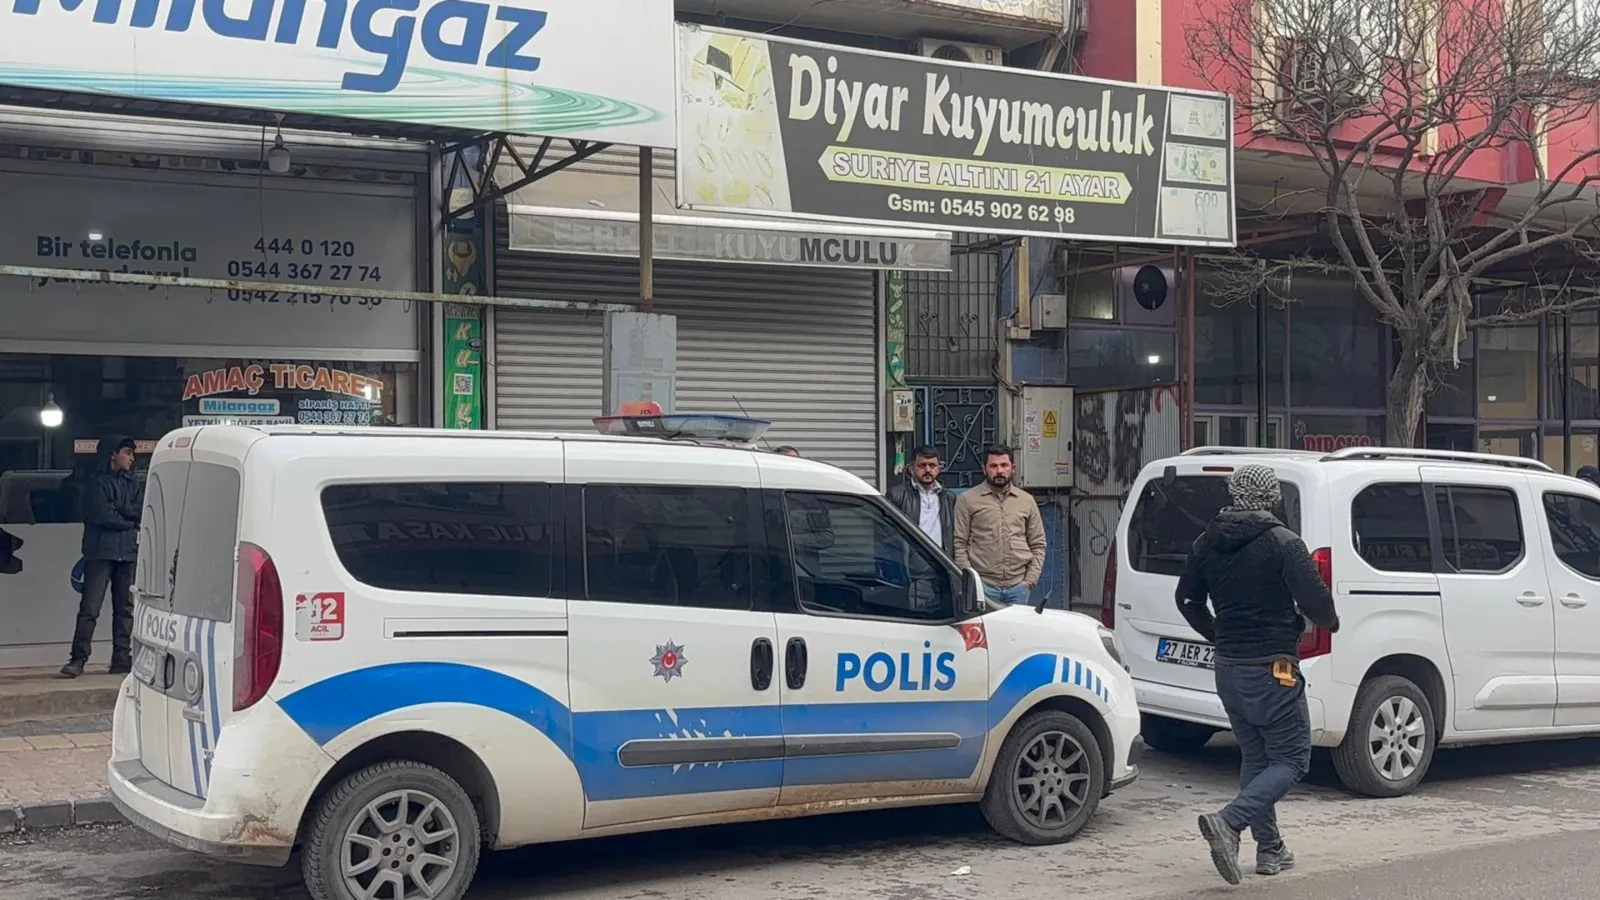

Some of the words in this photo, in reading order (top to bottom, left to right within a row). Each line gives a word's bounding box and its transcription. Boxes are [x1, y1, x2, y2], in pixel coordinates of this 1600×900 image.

[12, 0, 548, 92] angaz
[788, 53, 909, 142] Diyar
[922, 72, 1155, 157] Kuyumculuk
[936, 163, 1019, 192] ALTINI
[1024, 171, 1052, 194] 21
[1059, 174, 1121, 199] AYAR
[887, 193, 936, 214] Gsm:
[940, 198, 984, 217] 0545
[990, 202, 1023, 220] 902
[1028, 205, 1050, 222] 62
[1054, 206, 1076, 224] 98
[37, 236, 73, 257] Bir
[80, 238, 198, 262] telefonla
[253, 237, 294, 254] 444
[301, 239, 313, 255] 0
[320, 240, 355, 257] 120
[227, 260, 281, 278] 0544
[287, 262, 323, 280] 367
[330, 265, 352, 281] 27
[358, 266, 382, 282] 74
[183, 365, 264, 401] AMAÇ
[203, 400, 277, 413] Milangaz
[298, 410, 323, 422] 0544
[324, 411, 342, 422] 367
[343, 411, 356, 422] 27
[357, 411, 371, 422] 74
[1164, 642, 1178, 656] 27
[1180, 644, 1201, 660] AER
[835, 640, 956, 692] POLİS
